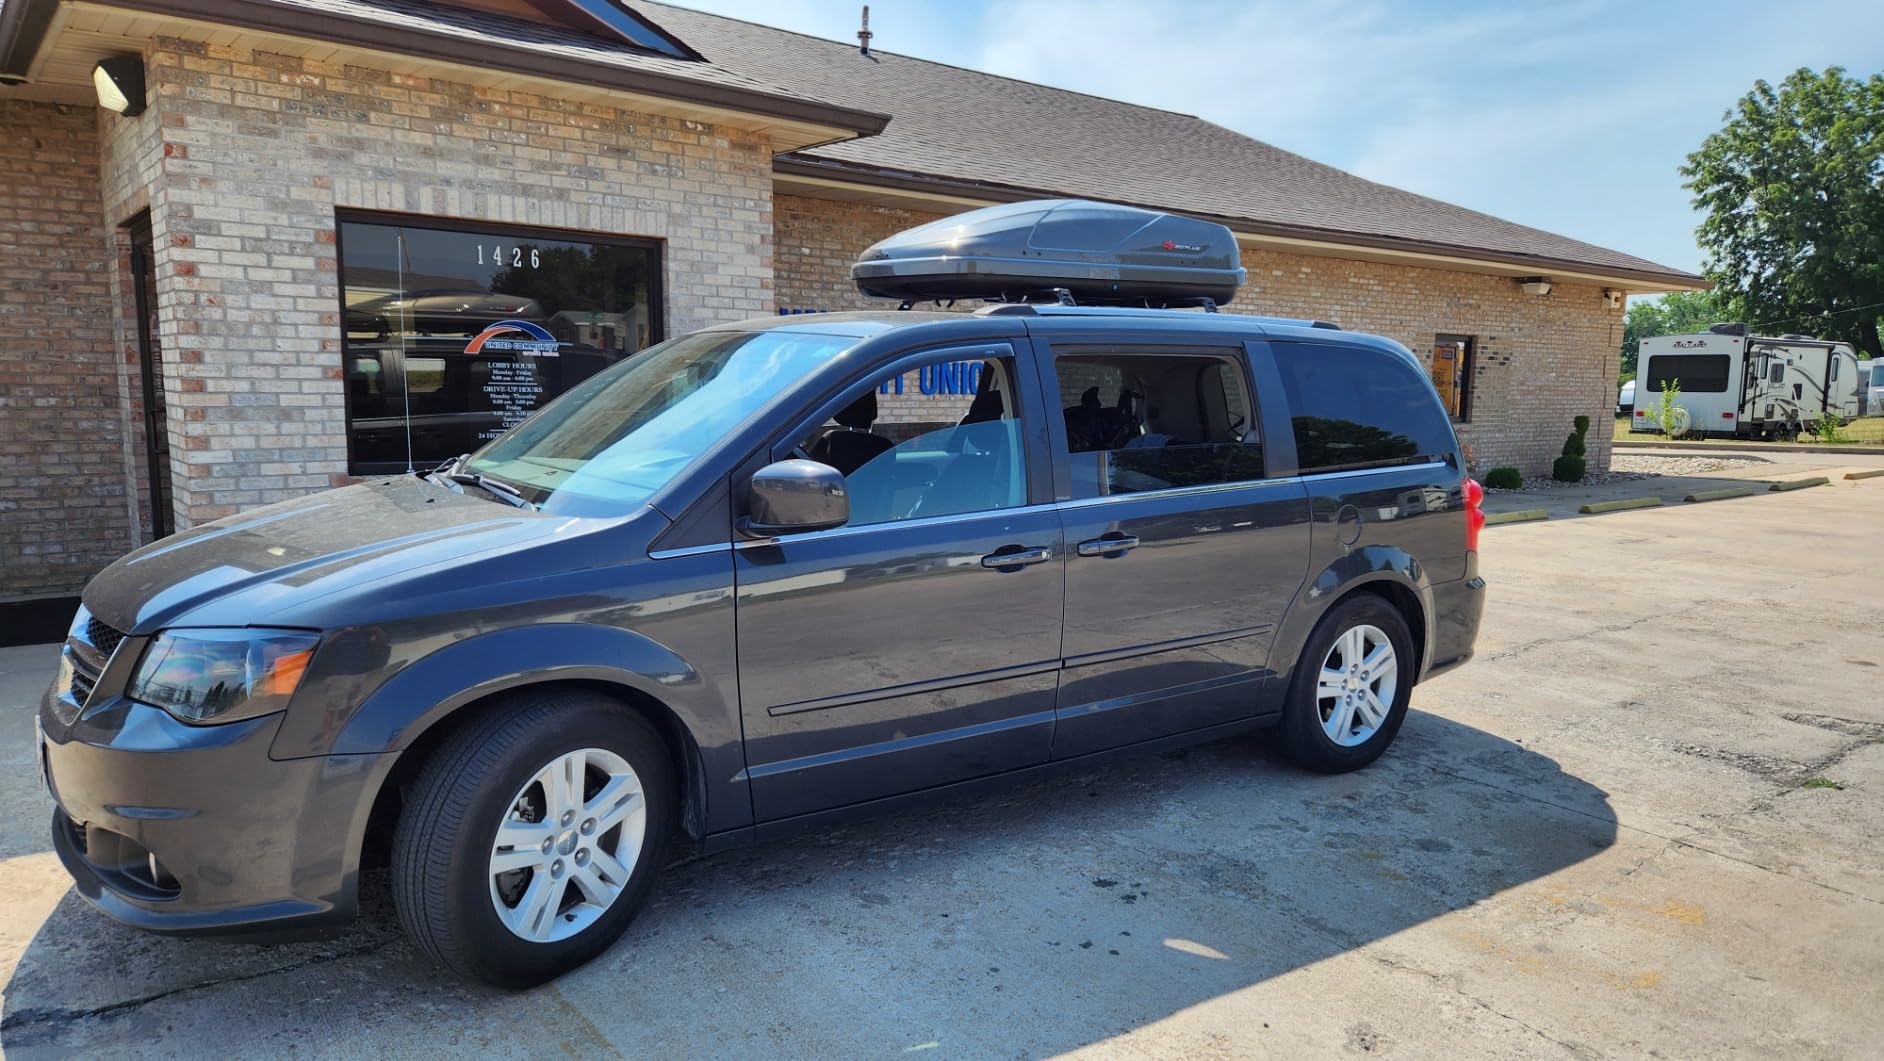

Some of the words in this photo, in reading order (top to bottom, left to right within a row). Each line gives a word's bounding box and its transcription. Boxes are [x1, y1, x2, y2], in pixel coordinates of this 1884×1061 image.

[477, 244, 540, 269] 1426
[513, 342, 559, 351] COMMUNITY
[919, 361, 984, 395] UNIO
